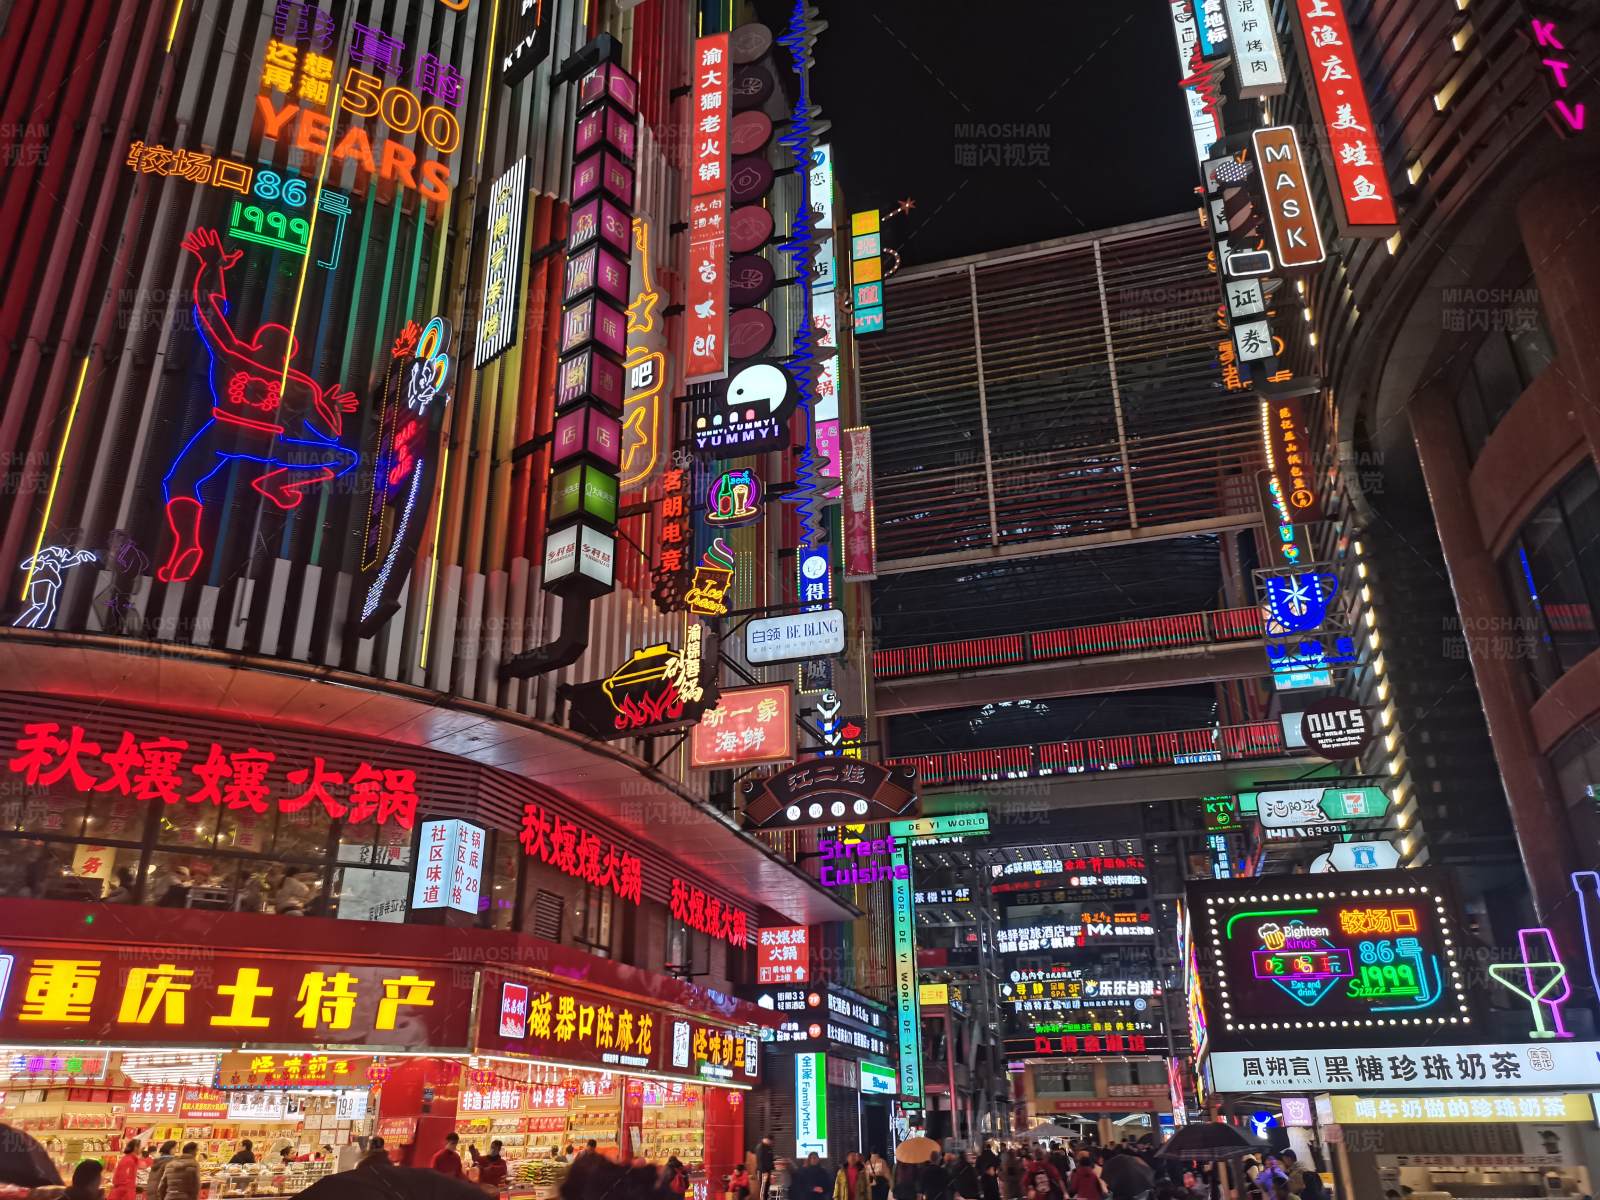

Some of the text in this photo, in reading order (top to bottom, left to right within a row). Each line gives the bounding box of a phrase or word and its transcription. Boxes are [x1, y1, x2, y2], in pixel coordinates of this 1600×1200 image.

[503, 29, 537, 73] KTV
[1531, 19, 1585, 131] KTV
[341, 67, 460, 153] 500
[255, 97, 451, 201] YEARS
[1265, 144, 1307, 249] MASK
[232, 202, 312, 244] 1999
[855, 312, 883, 328] KTV
[631, 363, 653, 388] 吧
[729, 417, 776, 430] YUMMY!
[697, 425, 779, 448] YUMMY!
[661, 469, 684, 574] 茗朗电竞
[702, 579, 723, 599] Ice
[753, 620, 839, 644] 白领 BE BLING
[714, 727, 766, 753] 海鲜
[1206, 801, 1235, 813] KTV
[929, 821, 939, 829] YI
[948, 817, 985, 828] WORLD
[819, 834, 898, 860] Street
[422, 825, 446, 904] 社区味道
[451, 825, 470, 905] 社区价格
[464, 830, 482, 894] 锅底28
[820, 860, 910, 887] Cuisine
[955, 888, 970, 898] 4F
[1087, 923, 1114, 936] MK
[1282, 925, 1330, 938] Eighteen
[1340, 909, 1417, 934] 较场口
[899, 931, 906, 943] DE
[769, 945, 798, 961] 火锅
[900, 953, 907, 963] YI
[1099, 980, 1154, 996] 乐乐台球
[1360, 964, 1415, 987] 1999
[18, 959, 436, 1031] 重庆土特产
[901, 973, 909, 1012] WORLD
[527, 991, 653, 1055] 磁器口陈麻花
[903, 1021, 910, 1033] DE
[693, 1027, 745, 1068] 怪味胡豆
[905, 1044, 911, 1055] YI
[1242, 1051, 1522, 1084] 周朔言 黑糖珍珠奶茶
[800, 1082, 811, 1136] FamilyMart
[1354, 1097, 1567, 1119] 喝牛奶做的珍珠奶茶
